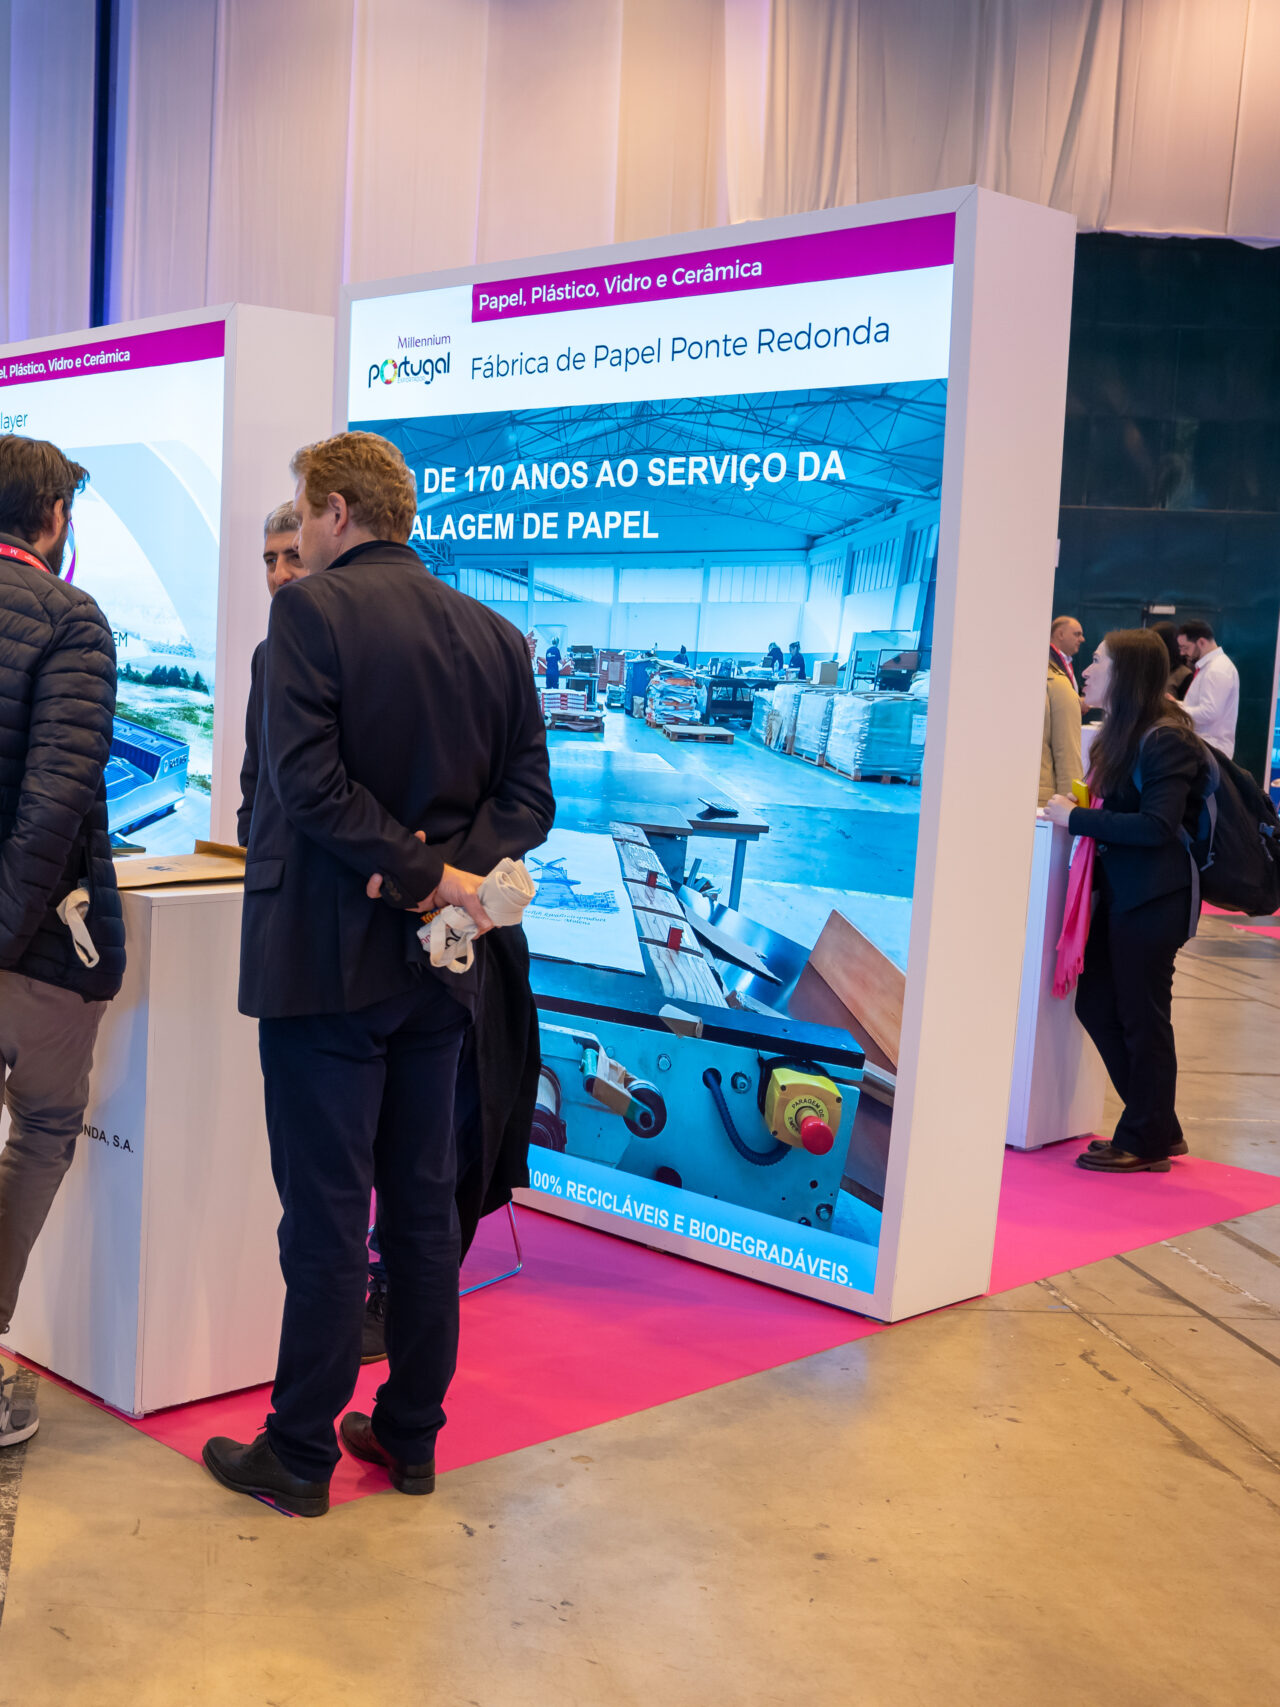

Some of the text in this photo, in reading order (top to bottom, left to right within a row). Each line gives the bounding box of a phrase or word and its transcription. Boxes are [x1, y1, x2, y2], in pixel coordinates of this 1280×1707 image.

[479, 259, 762, 312] Papel, Plástico, Vidro e Cerâmica
[397, 334, 451, 349] Millennium
[471, 316, 890, 380] Fábrica de Papel Ponte Redonda
[10, 362, 47, 378] Plástico,
[48, 357, 73, 372] Vidro
[75, 358, 81, 368] e
[83, 349, 130, 367] Cerâmica
[424, 467, 456, 494] DE
[464, 465, 505, 492] 170
[511, 461, 589, 491] ANOS
[595, 459, 639, 488] AO
[647, 452, 787, 492] SERVIÇO
[798, 450, 847, 482] DA
[523, 512, 558, 540] DE
[567, 510, 659, 540] PAPEL
[791, 1098, 821, 1109] PARAGEM
[81, 1123, 134, 1153] NDA, S.A.
[529, 1168, 853, 1287] 100% RECICLÁVEIS E BIODEGRADÁVEIS.
